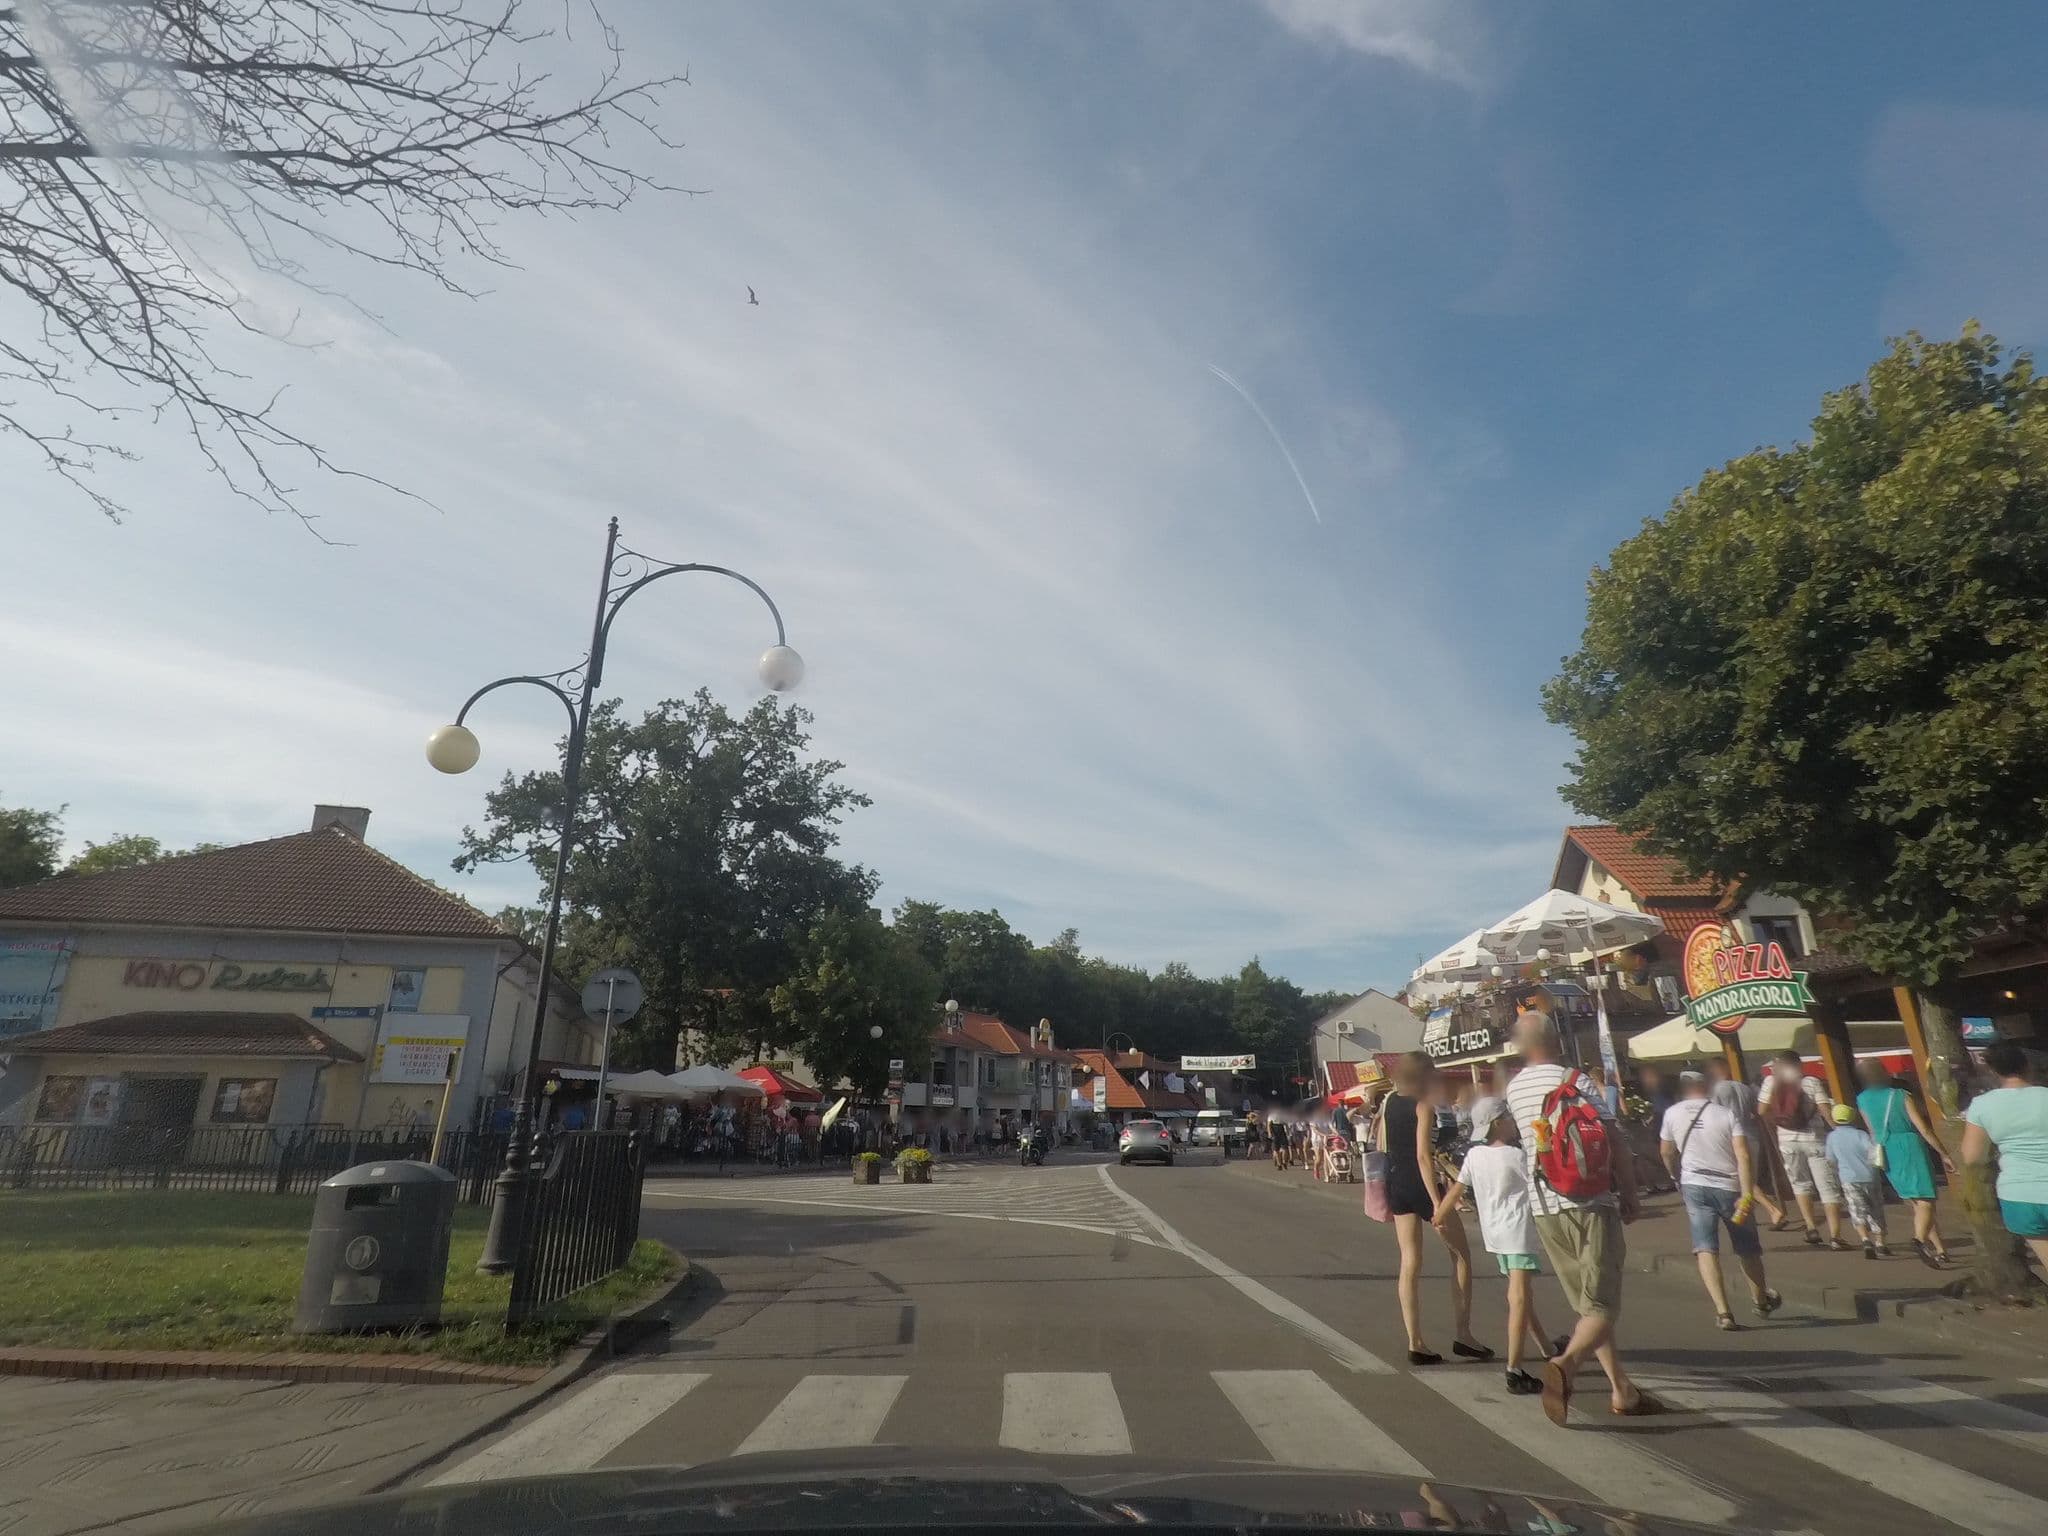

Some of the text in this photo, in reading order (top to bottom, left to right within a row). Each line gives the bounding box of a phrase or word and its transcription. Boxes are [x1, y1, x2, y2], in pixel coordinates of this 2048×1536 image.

[122, 960, 332, 992] KINO Rybak
[1713, 941, 1792, 986] PIZZA
[1694, 986, 1797, 1022] MANDRAGORA
[1424, 1029, 1491, 1057] DORSZ Z PIECA
